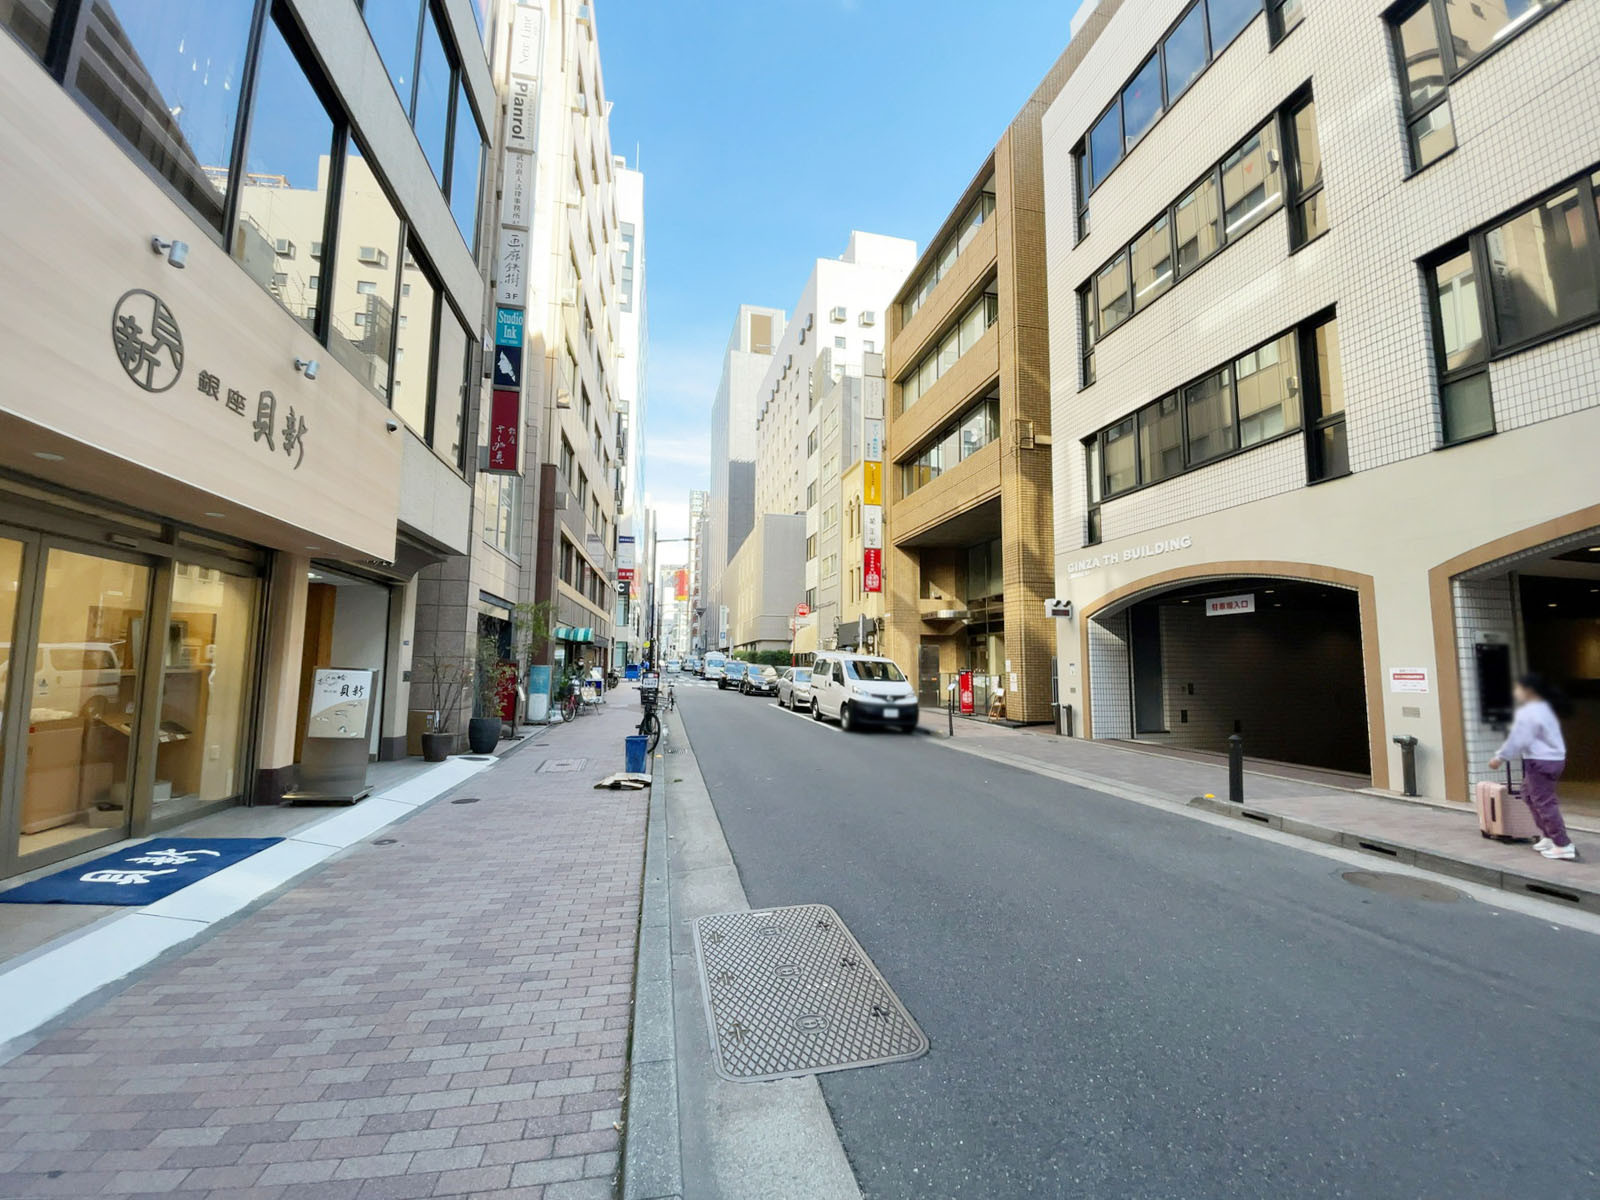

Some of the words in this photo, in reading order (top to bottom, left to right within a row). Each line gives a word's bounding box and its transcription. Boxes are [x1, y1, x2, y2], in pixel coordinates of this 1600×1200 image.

[505, 292, 519, 300] 3F
[498, 310, 523, 325] Studio
[503, 325, 517, 339] Ink
[1067, 558, 1100, 573] GINZA
[1102, 552, 1120, 566] TH
[1123, 536, 1192, 562] BUILDING
